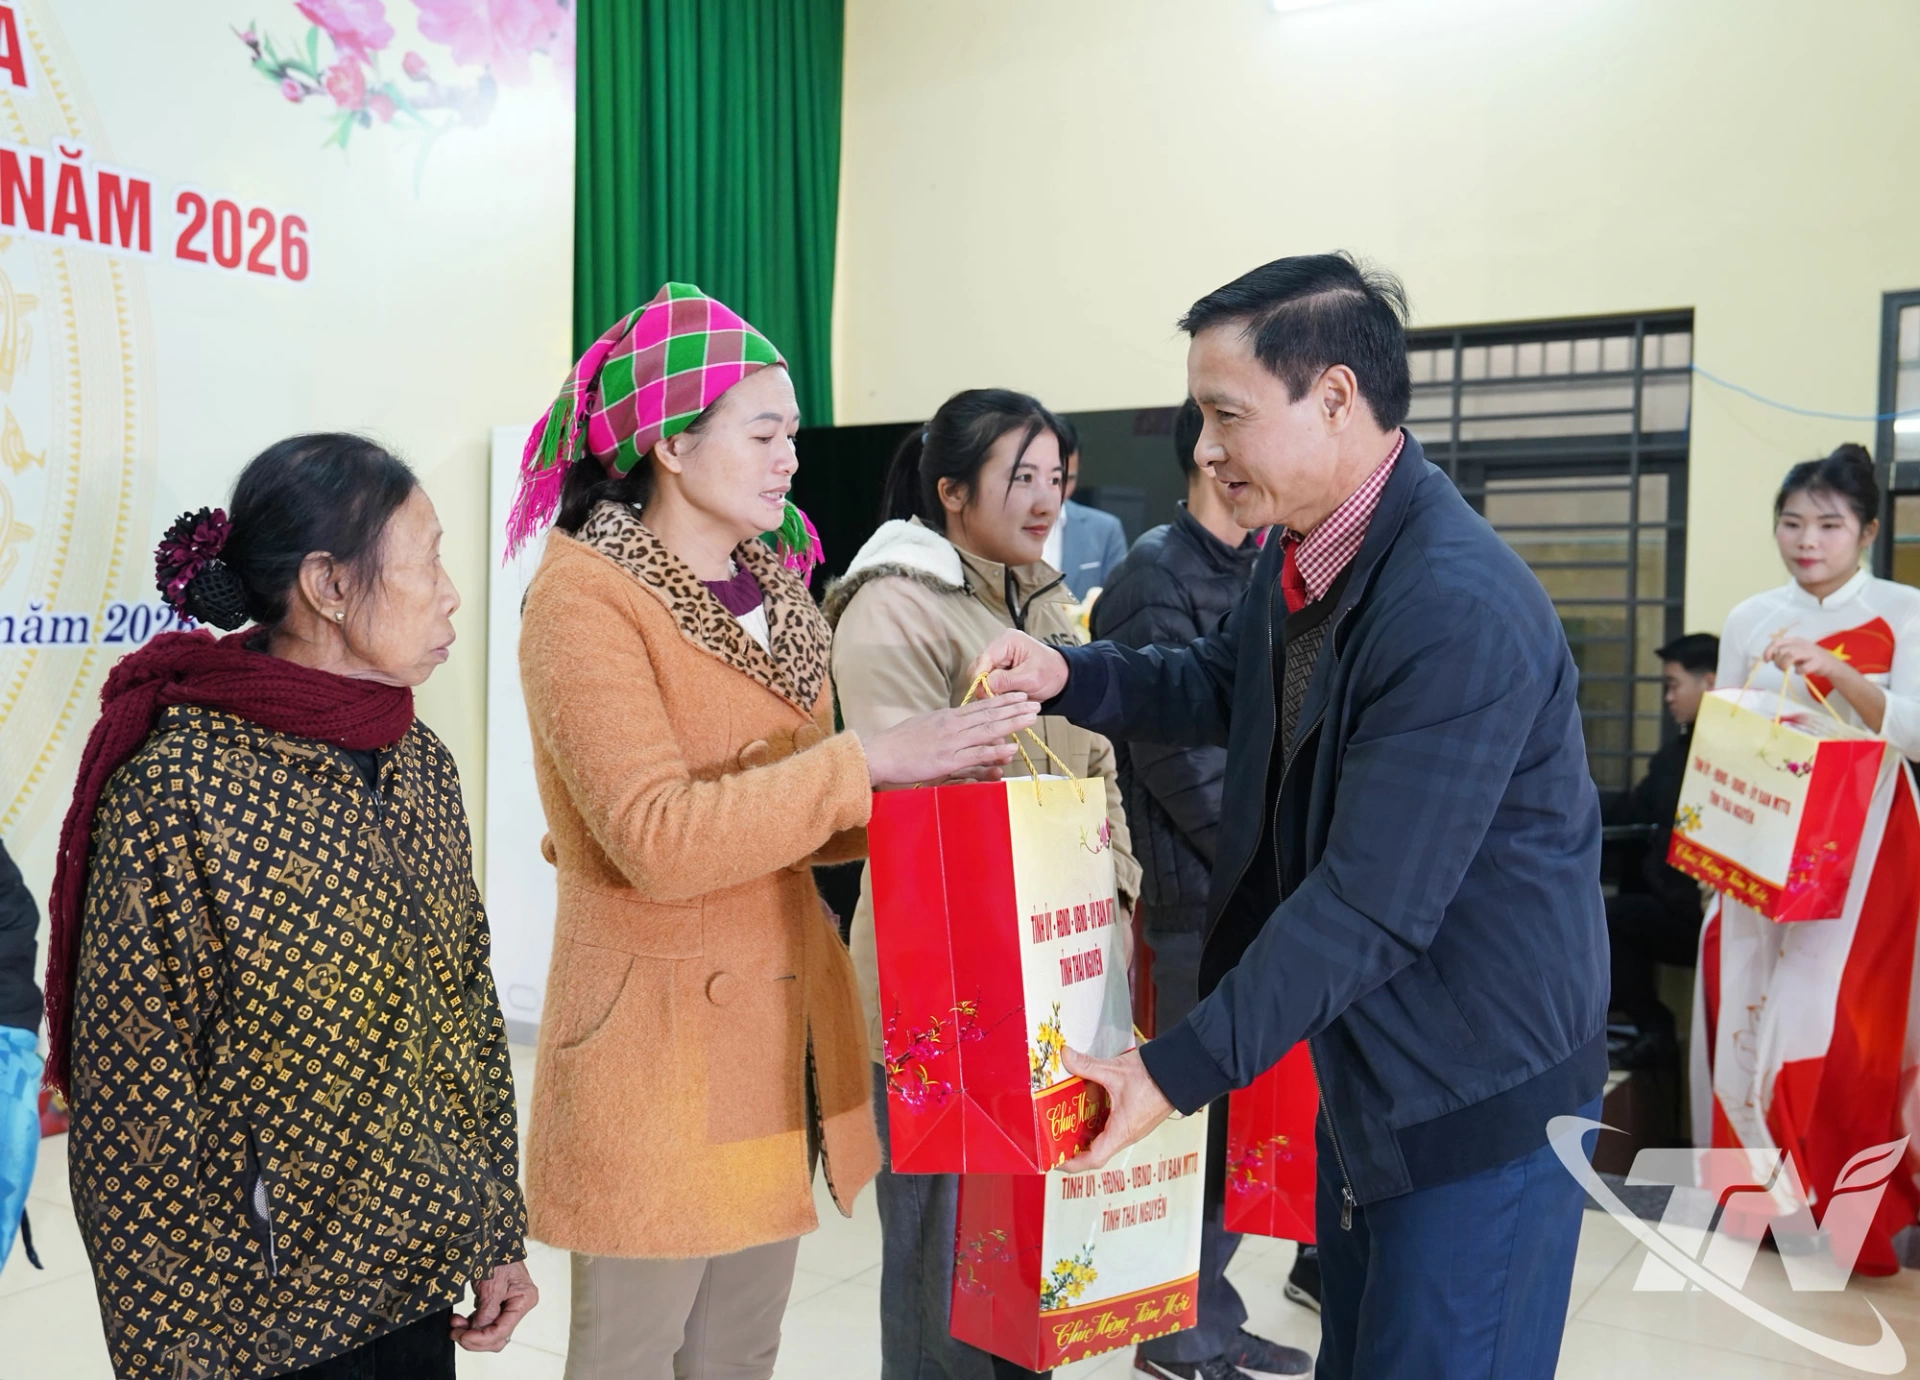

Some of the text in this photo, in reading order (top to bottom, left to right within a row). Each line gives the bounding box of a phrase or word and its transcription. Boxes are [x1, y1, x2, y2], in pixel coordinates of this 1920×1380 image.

[0, 144, 309, 282] NĂM 2026
[1095, 899, 1107, 928] BAN
[1060, 943, 1104, 987] TỈNH THÁI NGUYÊN
[1046, 1100, 1079, 1141] Chúc
[1132, 1164, 1152, 1189] UBND
[1168, 1156, 1182, 1180] BAN
[1102, 1193, 1168, 1233] TỈNH THÁI NGUYÊN
[1052, 1319, 1097, 1350] Chúc
[1092, 1311, 1130, 1339] Mừng
[1155, 1292, 1192, 1323] Mới
